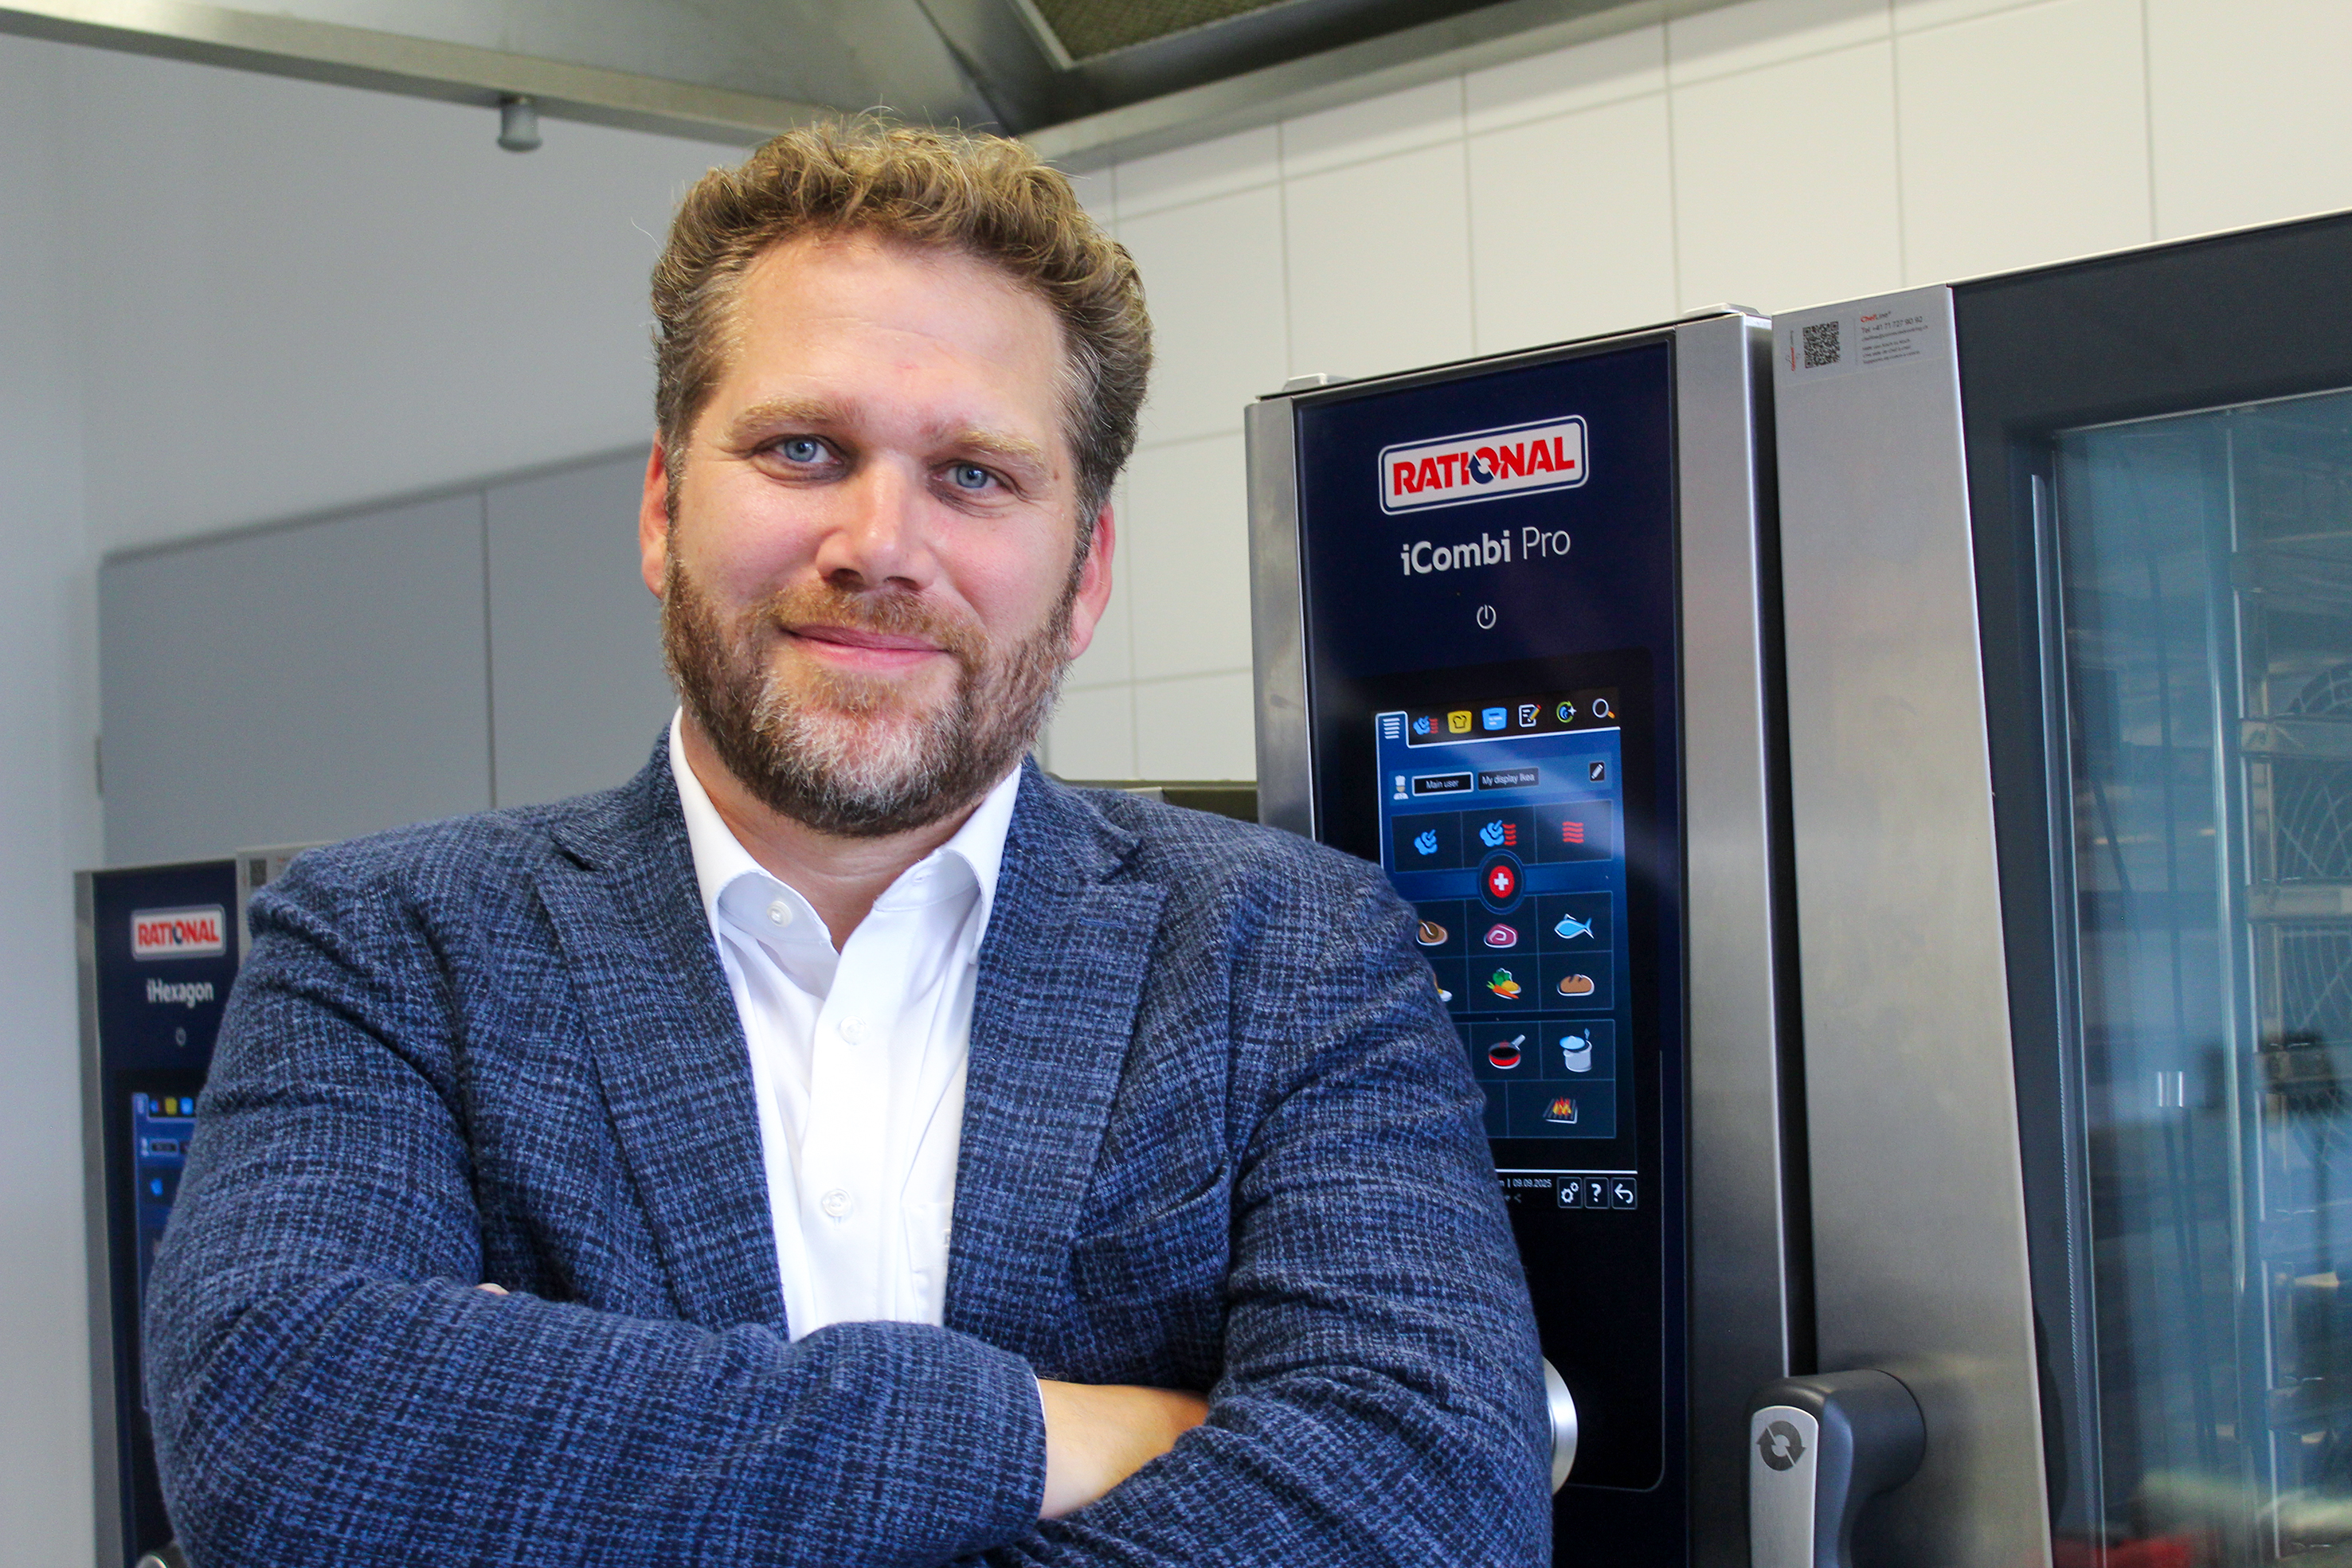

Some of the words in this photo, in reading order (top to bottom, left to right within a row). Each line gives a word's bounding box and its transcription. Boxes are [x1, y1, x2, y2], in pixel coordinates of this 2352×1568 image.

[1393, 436, 1575, 496] RATIONAL
[1400, 530, 1512, 576] iCombi
[1522, 526, 1571, 560] Pro
[1426, 780, 1442, 789] Main
[1444, 780, 1459, 788] user
[1482, 776, 1493, 786] My
[1494, 773, 1519, 785] display
[1519, 772, 1535, 782] Ikea
[138, 918, 220, 946] RATIONAL
[147, 978, 213, 1009] iHexagon
[1513, 1178, 1552, 1188] 09.09.2025
